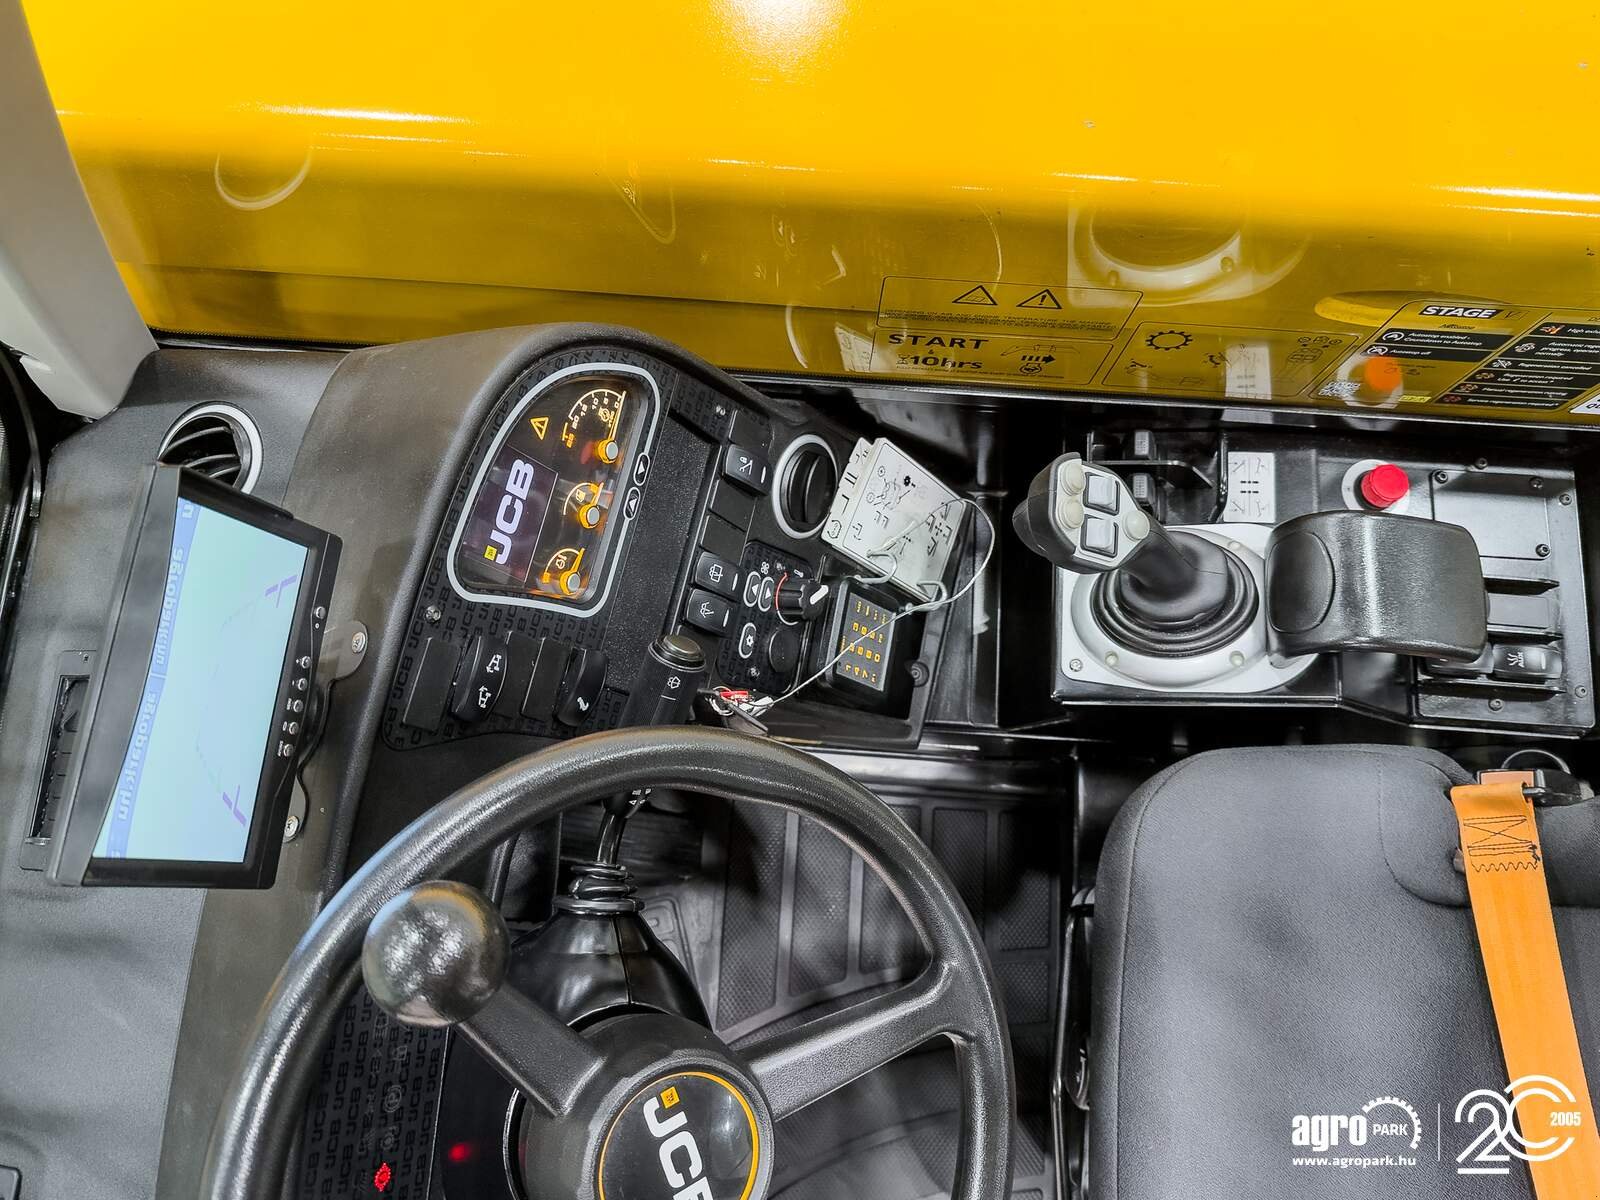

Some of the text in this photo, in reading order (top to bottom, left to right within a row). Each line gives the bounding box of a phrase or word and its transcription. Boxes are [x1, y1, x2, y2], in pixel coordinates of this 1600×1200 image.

[1423, 306, 1496, 319] STAGE
[889, 333, 990, 350] START
[909, 355, 983, 370] 10hrs
[490, 458, 535, 565] JCB
[1517, 651, 1525, 668] AUX
